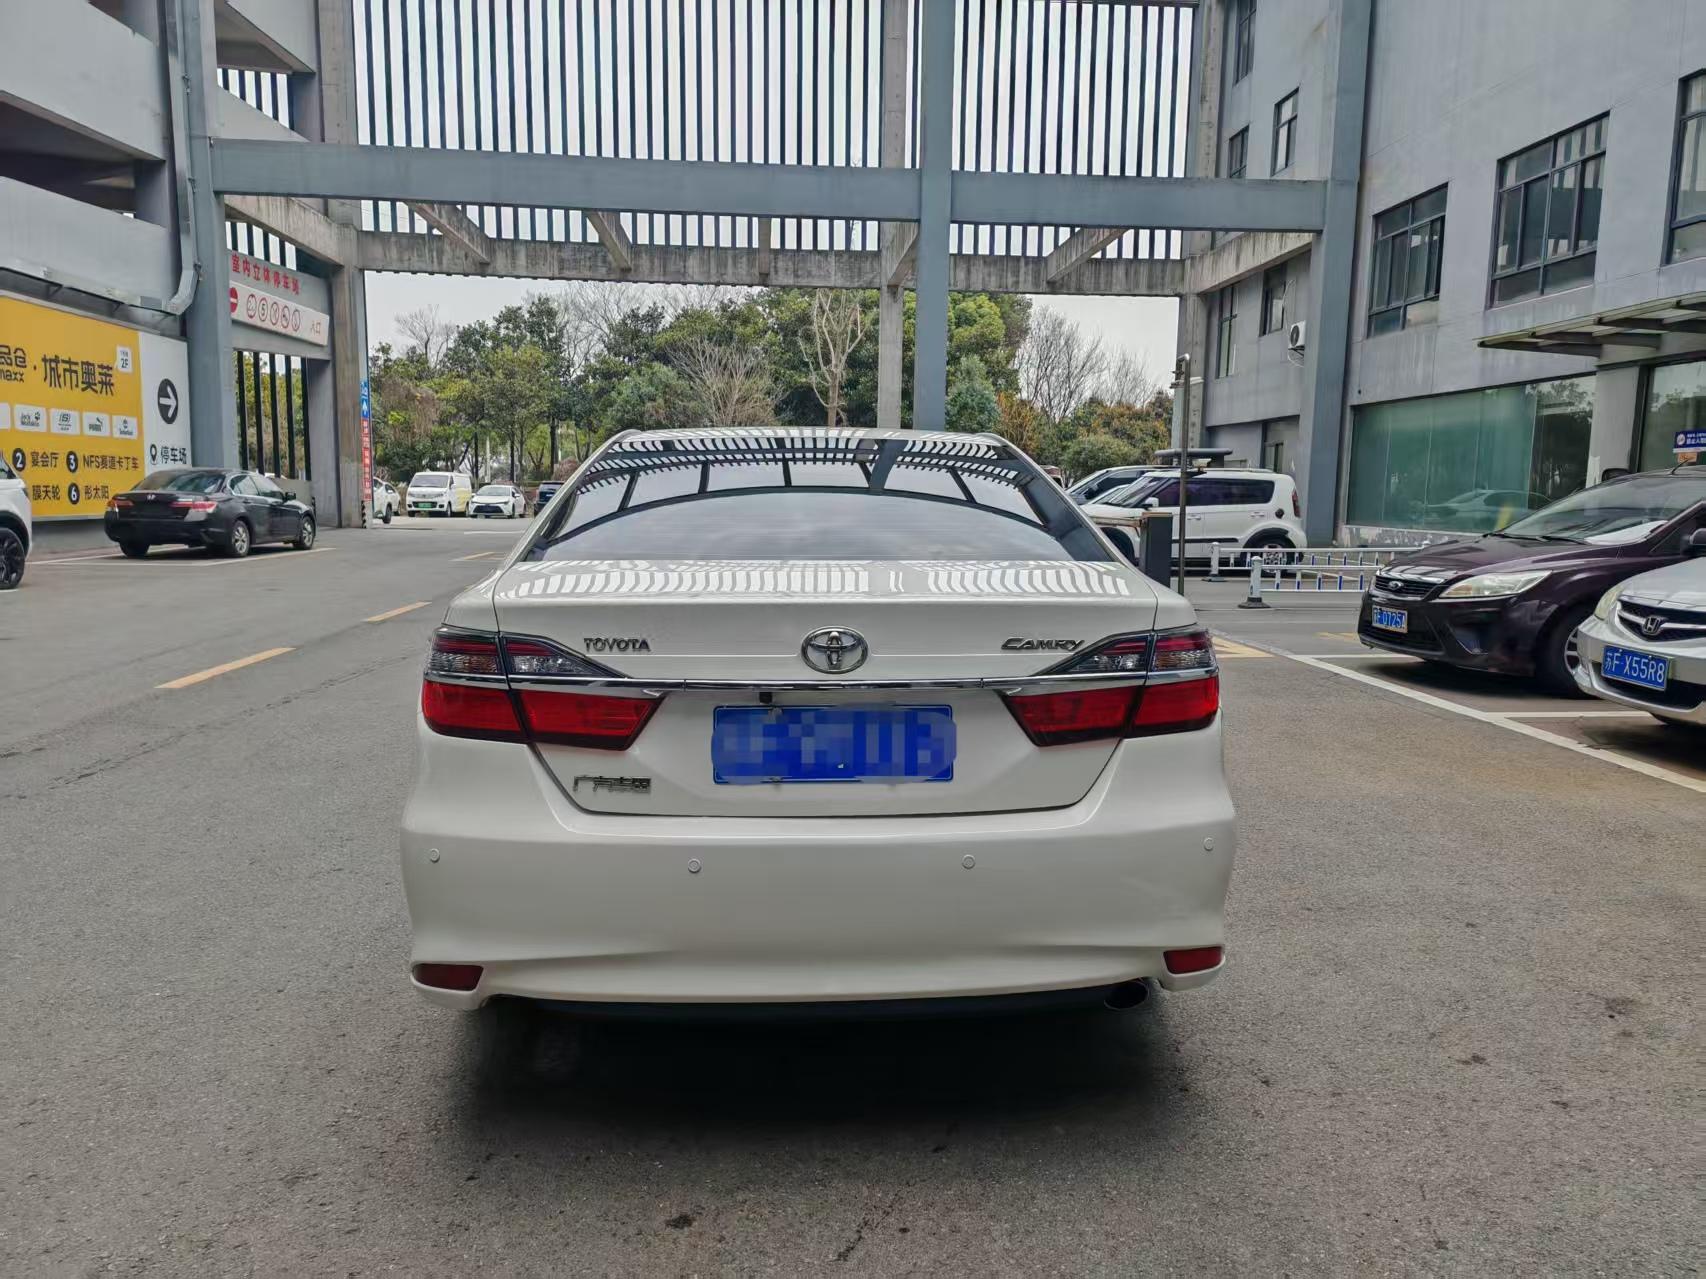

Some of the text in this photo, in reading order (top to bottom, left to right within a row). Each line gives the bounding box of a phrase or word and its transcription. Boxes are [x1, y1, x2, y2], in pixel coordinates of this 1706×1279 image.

[231, 253, 299, 295] 室内立体停车场
[31, 452, 60, 468] 宴会厅
[160, 446, 187, 464] 停车场
[583, 637, 652, 653] TOYOTA
[1001, 636, 1085, 652] CAMRY
